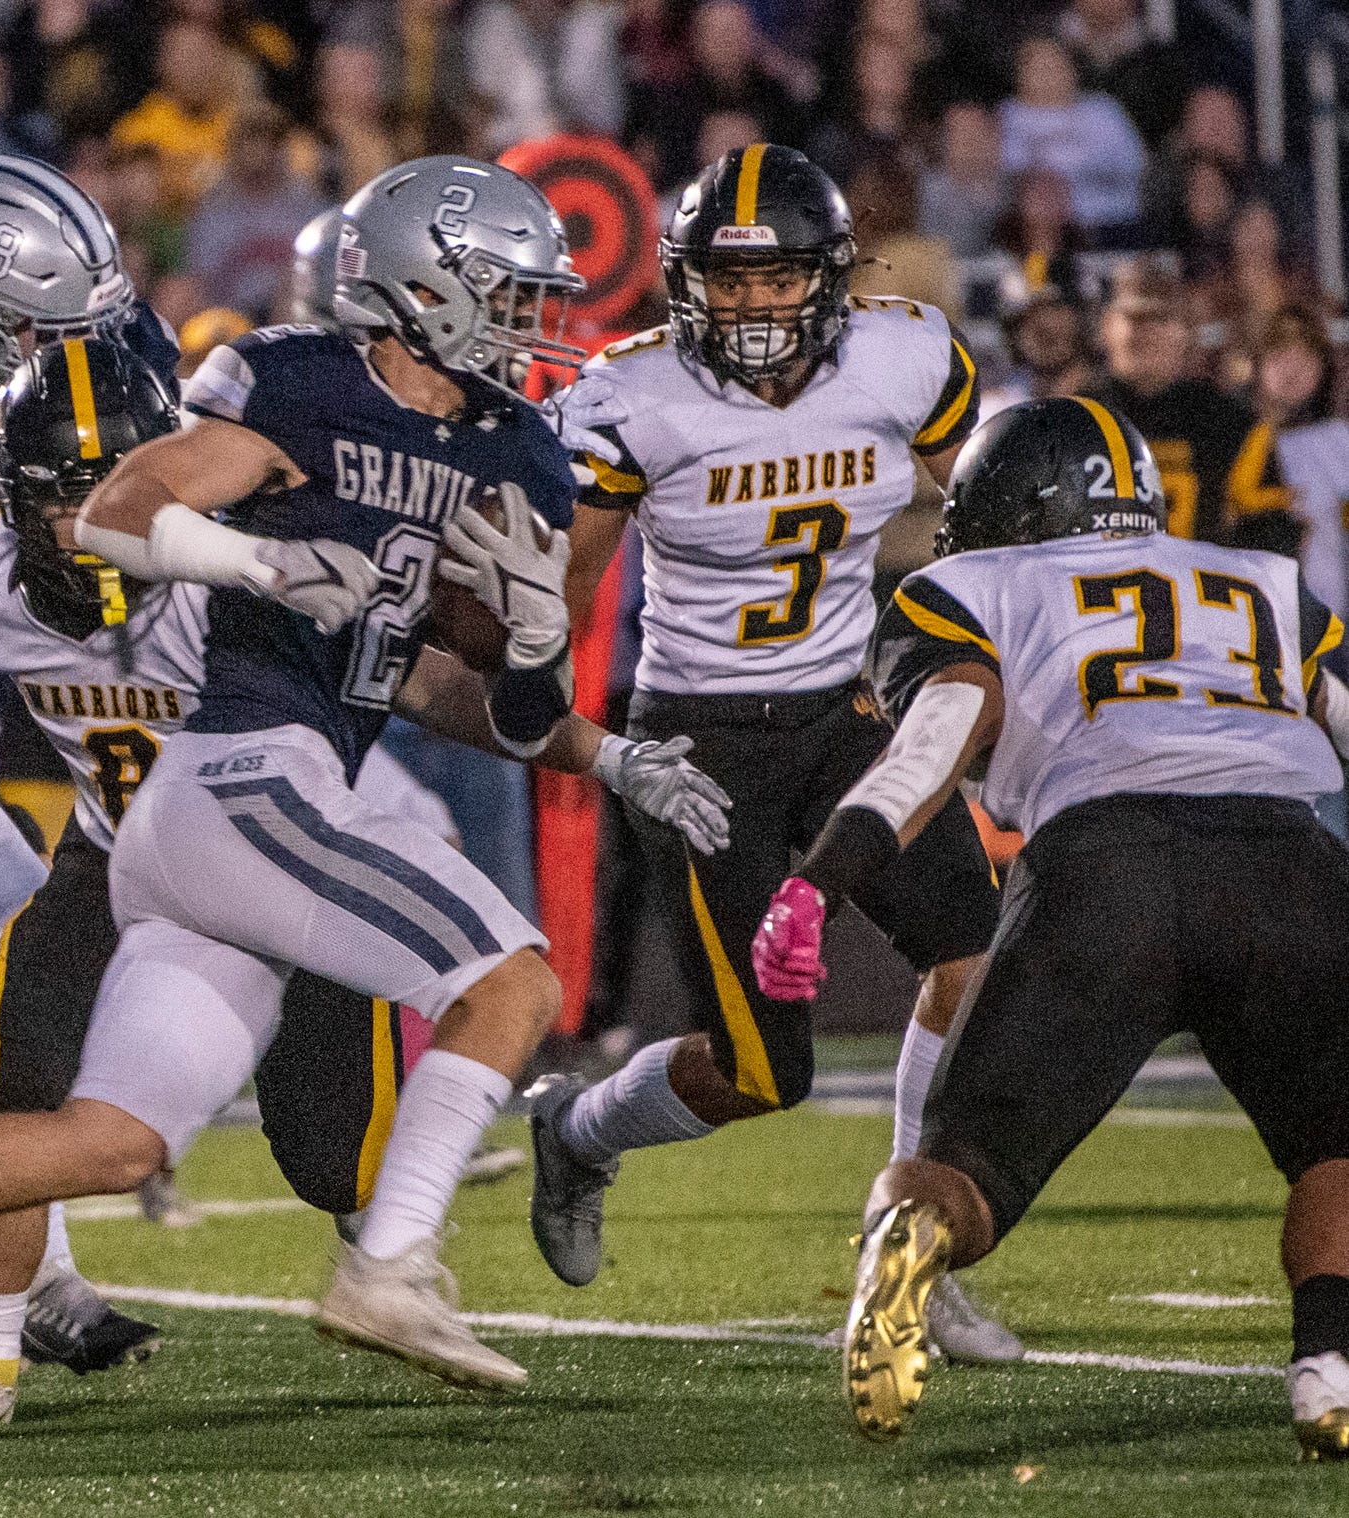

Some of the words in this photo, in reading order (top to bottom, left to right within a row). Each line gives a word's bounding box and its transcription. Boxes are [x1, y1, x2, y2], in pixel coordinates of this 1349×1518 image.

[433, 184, 478, 238] 2
[706, 444, 877, 505] WARRIORS
[1091, 511, 1159, 532] XENITH
[340, 521, 442, 711] 2
[736, 498, 852, 648] 3
[1071, 566, 1302, 723] 23
